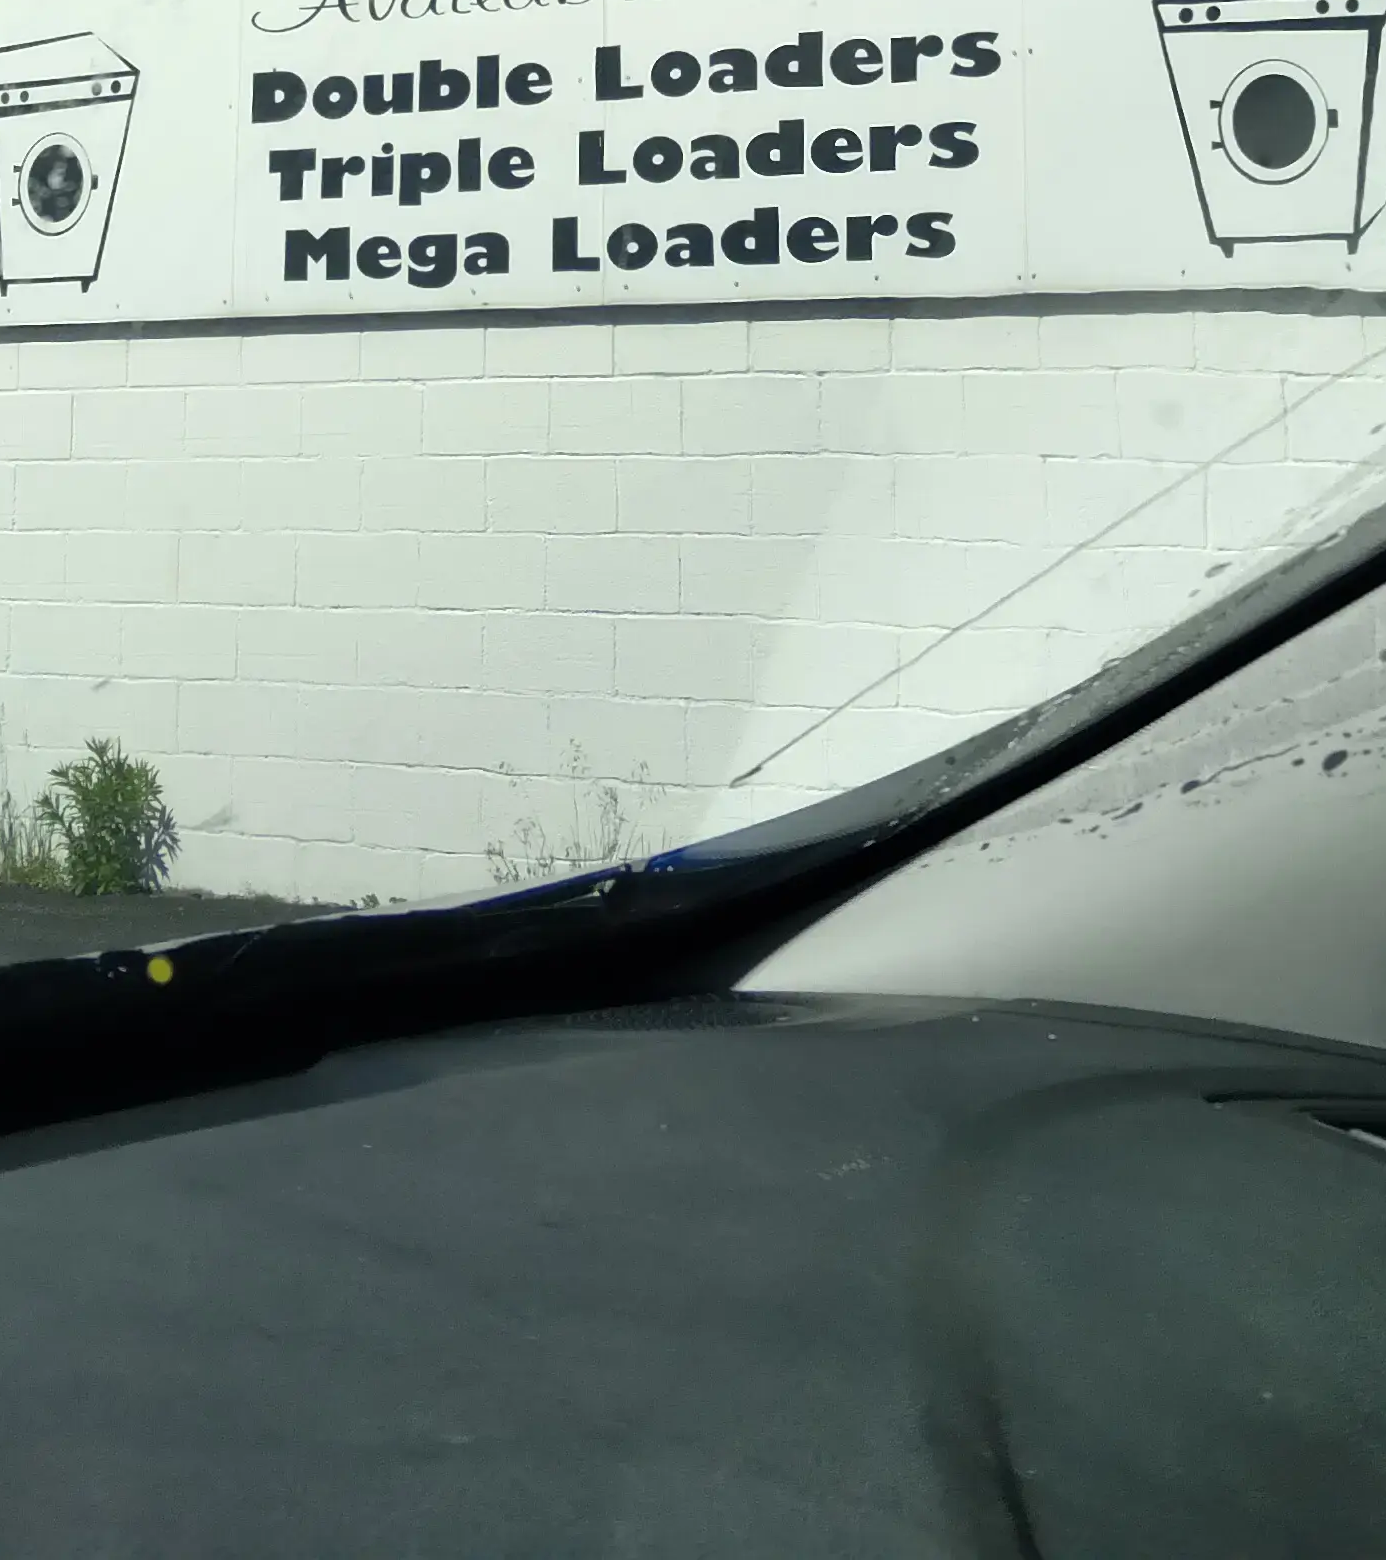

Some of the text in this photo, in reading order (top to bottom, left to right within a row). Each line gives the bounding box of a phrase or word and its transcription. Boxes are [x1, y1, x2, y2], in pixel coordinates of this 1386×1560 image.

[250, 29, 1002, 124] Double Loaders
[268, 118, 981, 206] Triple Loaders
[282, 206, 957, 289] Mega Loaders
